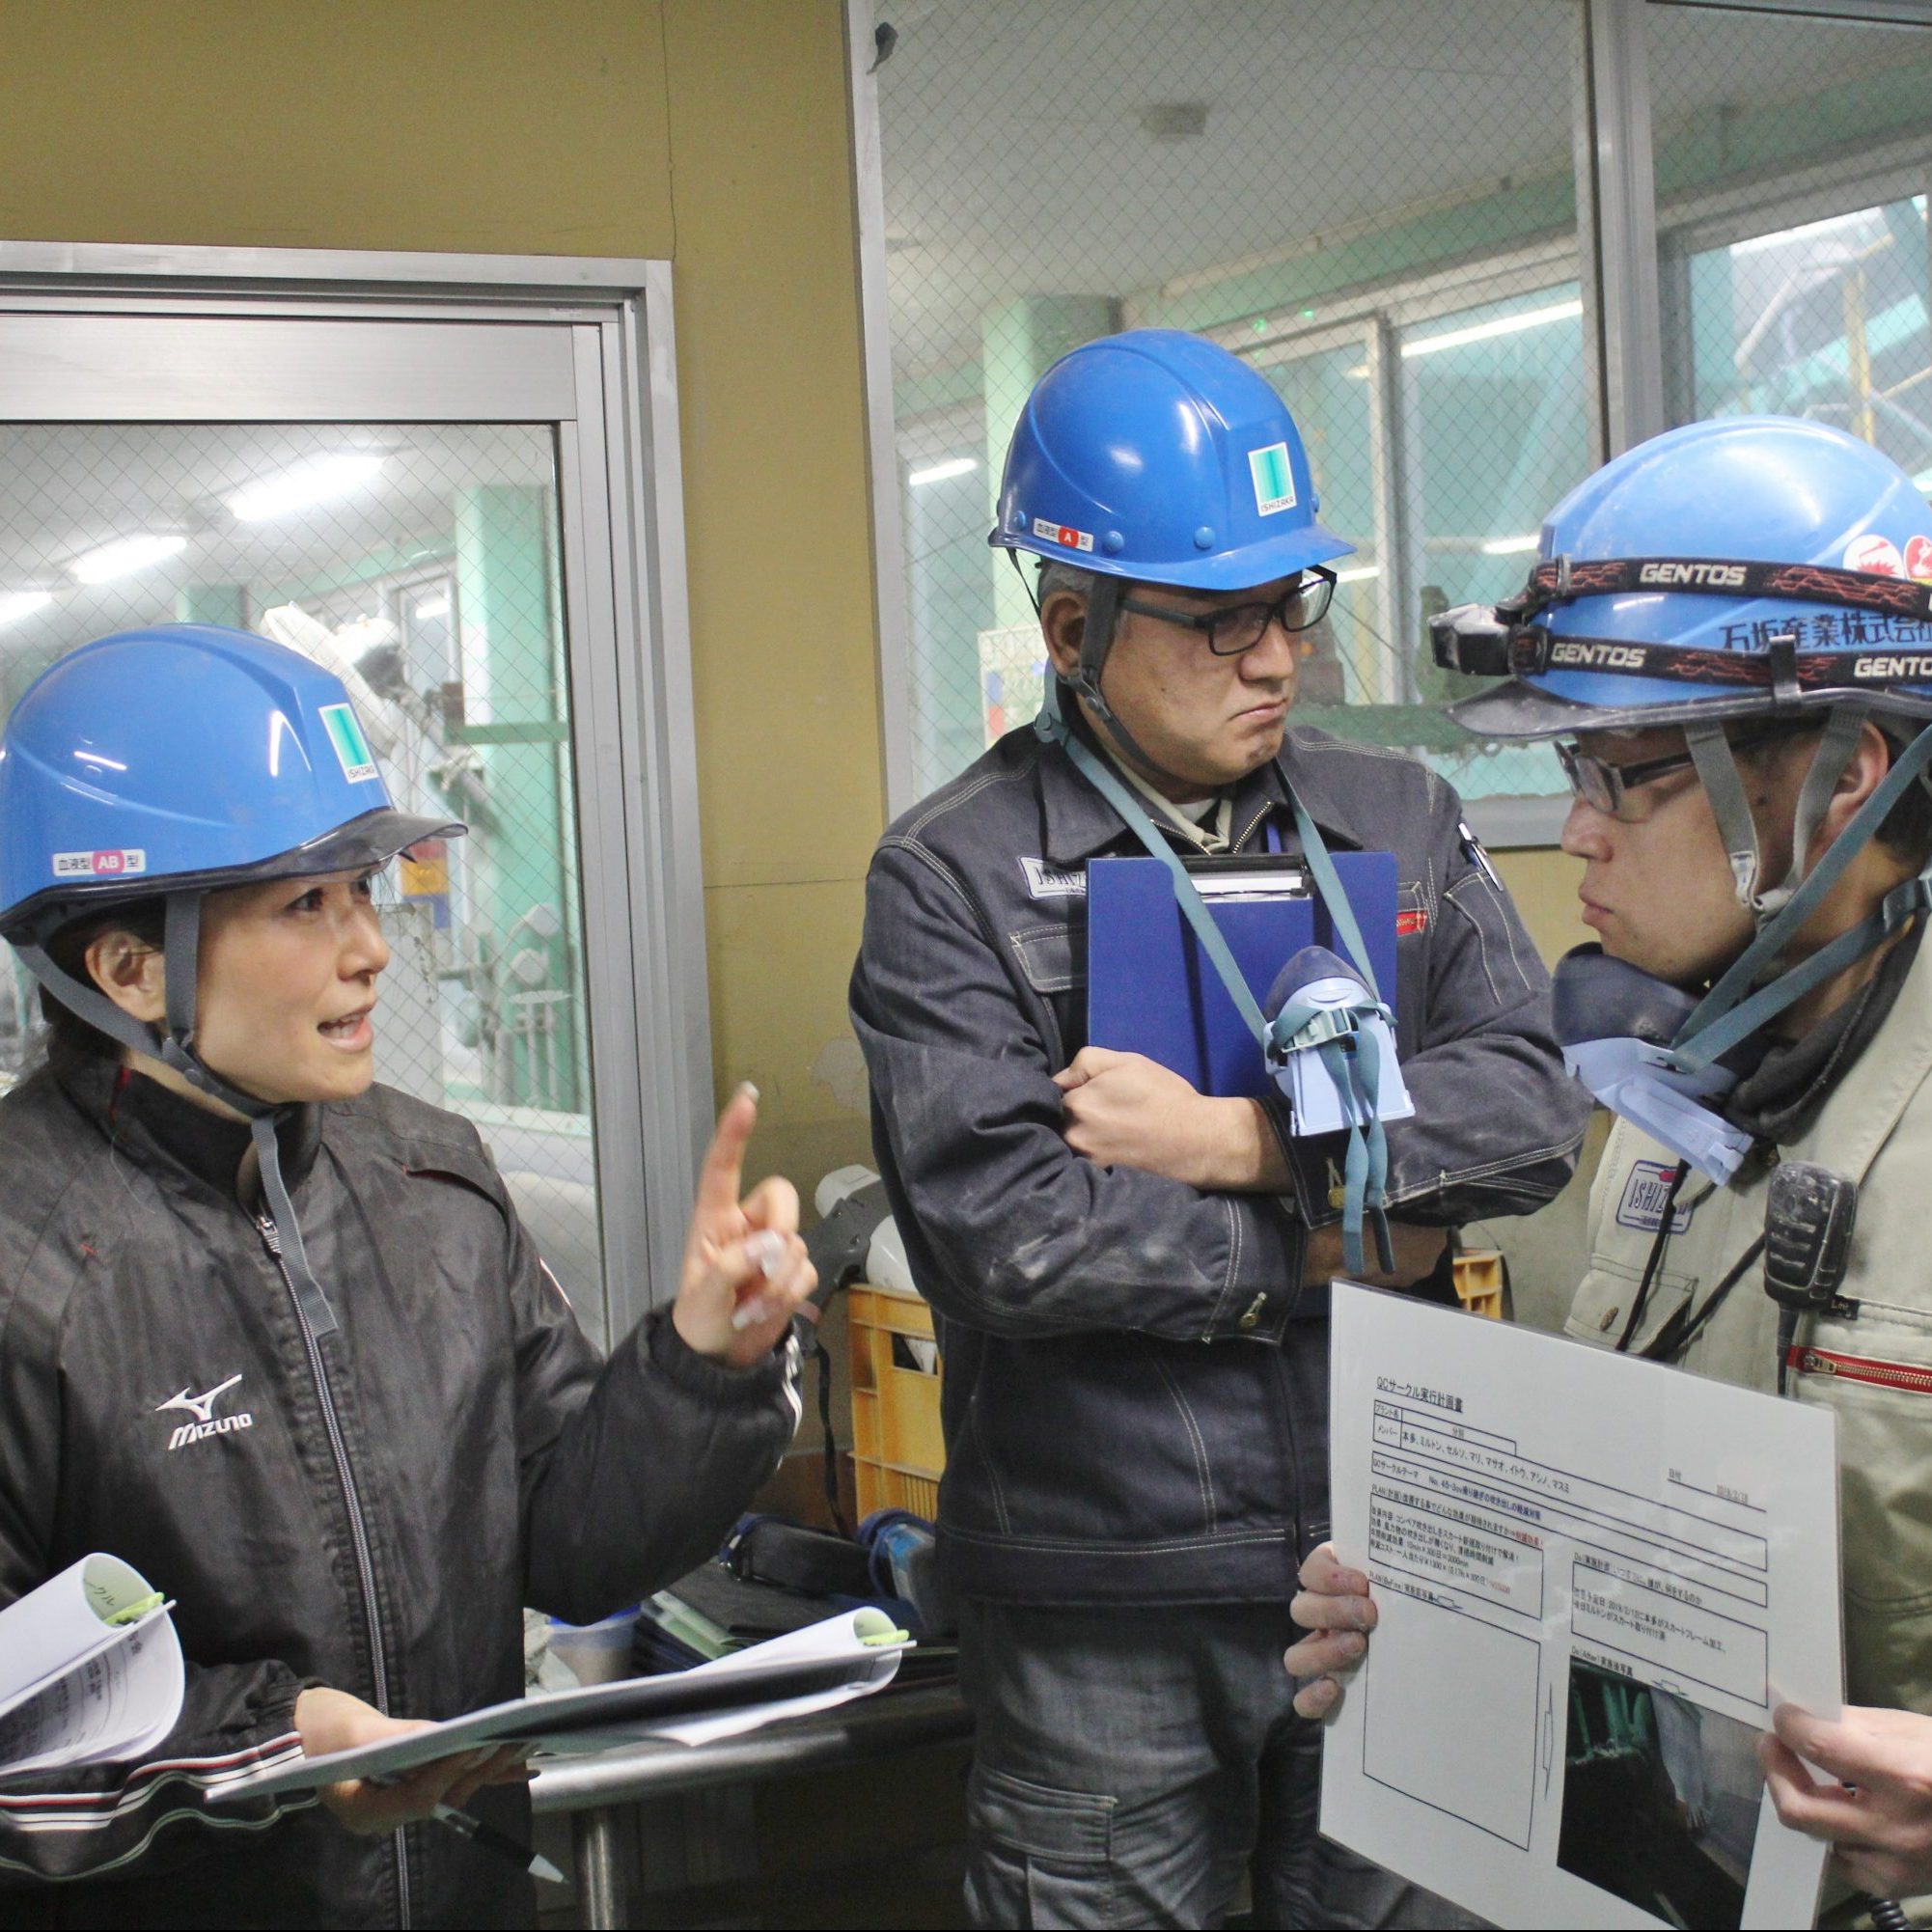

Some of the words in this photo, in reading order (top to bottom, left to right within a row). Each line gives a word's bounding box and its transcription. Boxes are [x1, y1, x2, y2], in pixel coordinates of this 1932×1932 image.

[1259, 496, 1294, 512] ISHIZAKA
[1641, 564, 1748, 586] GENTOS
[1551, 643, 1646, 668] GENTOS
[98, 855, 119, 869] AB
[1376, 1375, 1463, 1413] QCサークル実行計画書
